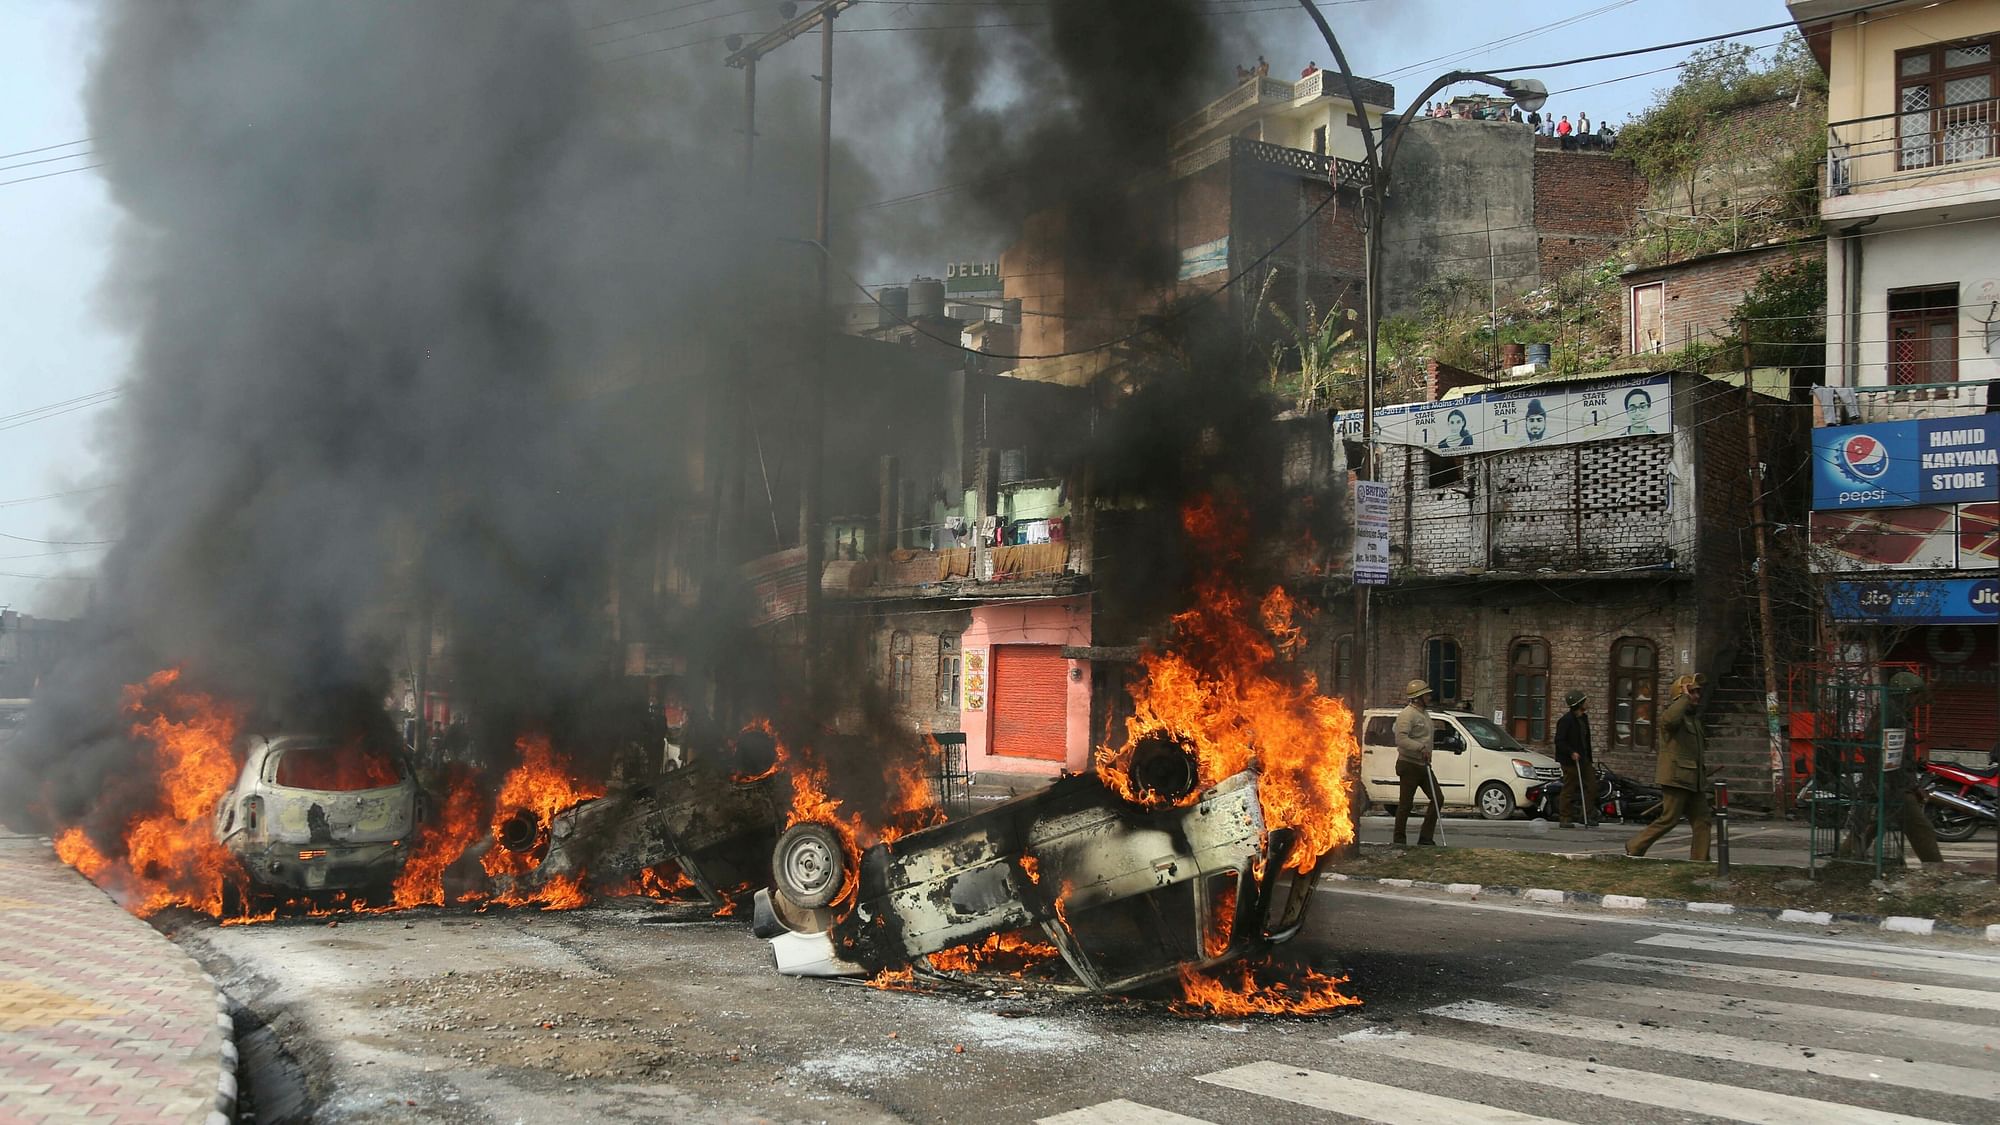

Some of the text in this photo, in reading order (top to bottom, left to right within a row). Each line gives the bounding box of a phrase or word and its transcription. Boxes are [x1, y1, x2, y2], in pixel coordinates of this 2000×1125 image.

[946, 259, 998, 278] DELHI
[1582, 391, 1607, 401] STATE
[1583, 398, 1608, 408] RANK
[1431, 397, 1472, 410] Mains-2017
[1494, 401, 1516, 410] STATE
[1414, 411, 1435, 419] STATE
[1494, 407, 1517, 417] RANK
[1591, 410, 1598, 427] 1
[1415, 417, 1436, 426] RANK
[1502, 419, 1508, 434] 1
[1421, 429, 1428, 443] 1
[1930, 428, 1985, 447] HAMID
[1922, 448, 1999, 470] KARYANA
[1932, 472, 1985, 491] STORE
[1839, 487, 1886, 505] pepsi
[1860, 589, 1892, 606] Jio
